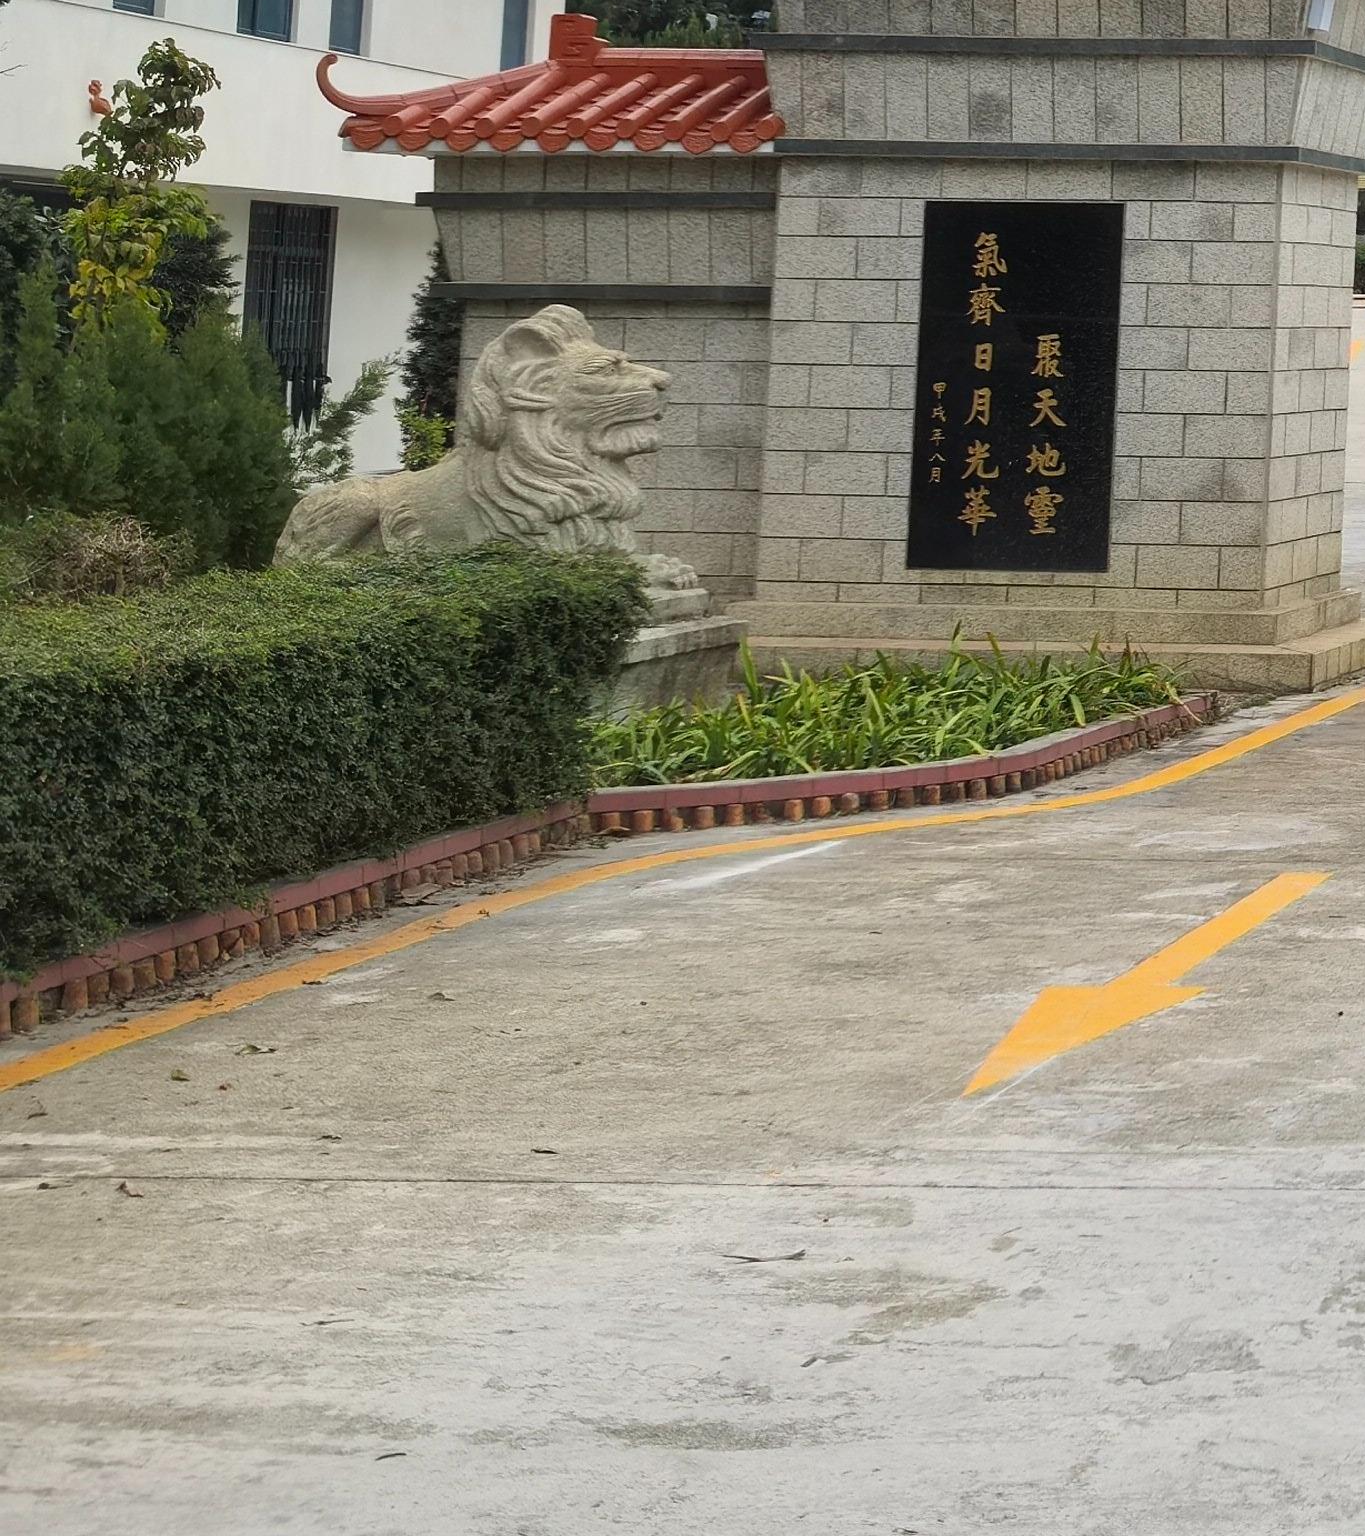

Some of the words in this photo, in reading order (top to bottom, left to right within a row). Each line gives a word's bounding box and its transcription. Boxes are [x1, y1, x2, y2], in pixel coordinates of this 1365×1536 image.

[957, 231, 1008, 537] 氣齊日月光華
[1025, 333, 1069, 536] 聚天地靈
